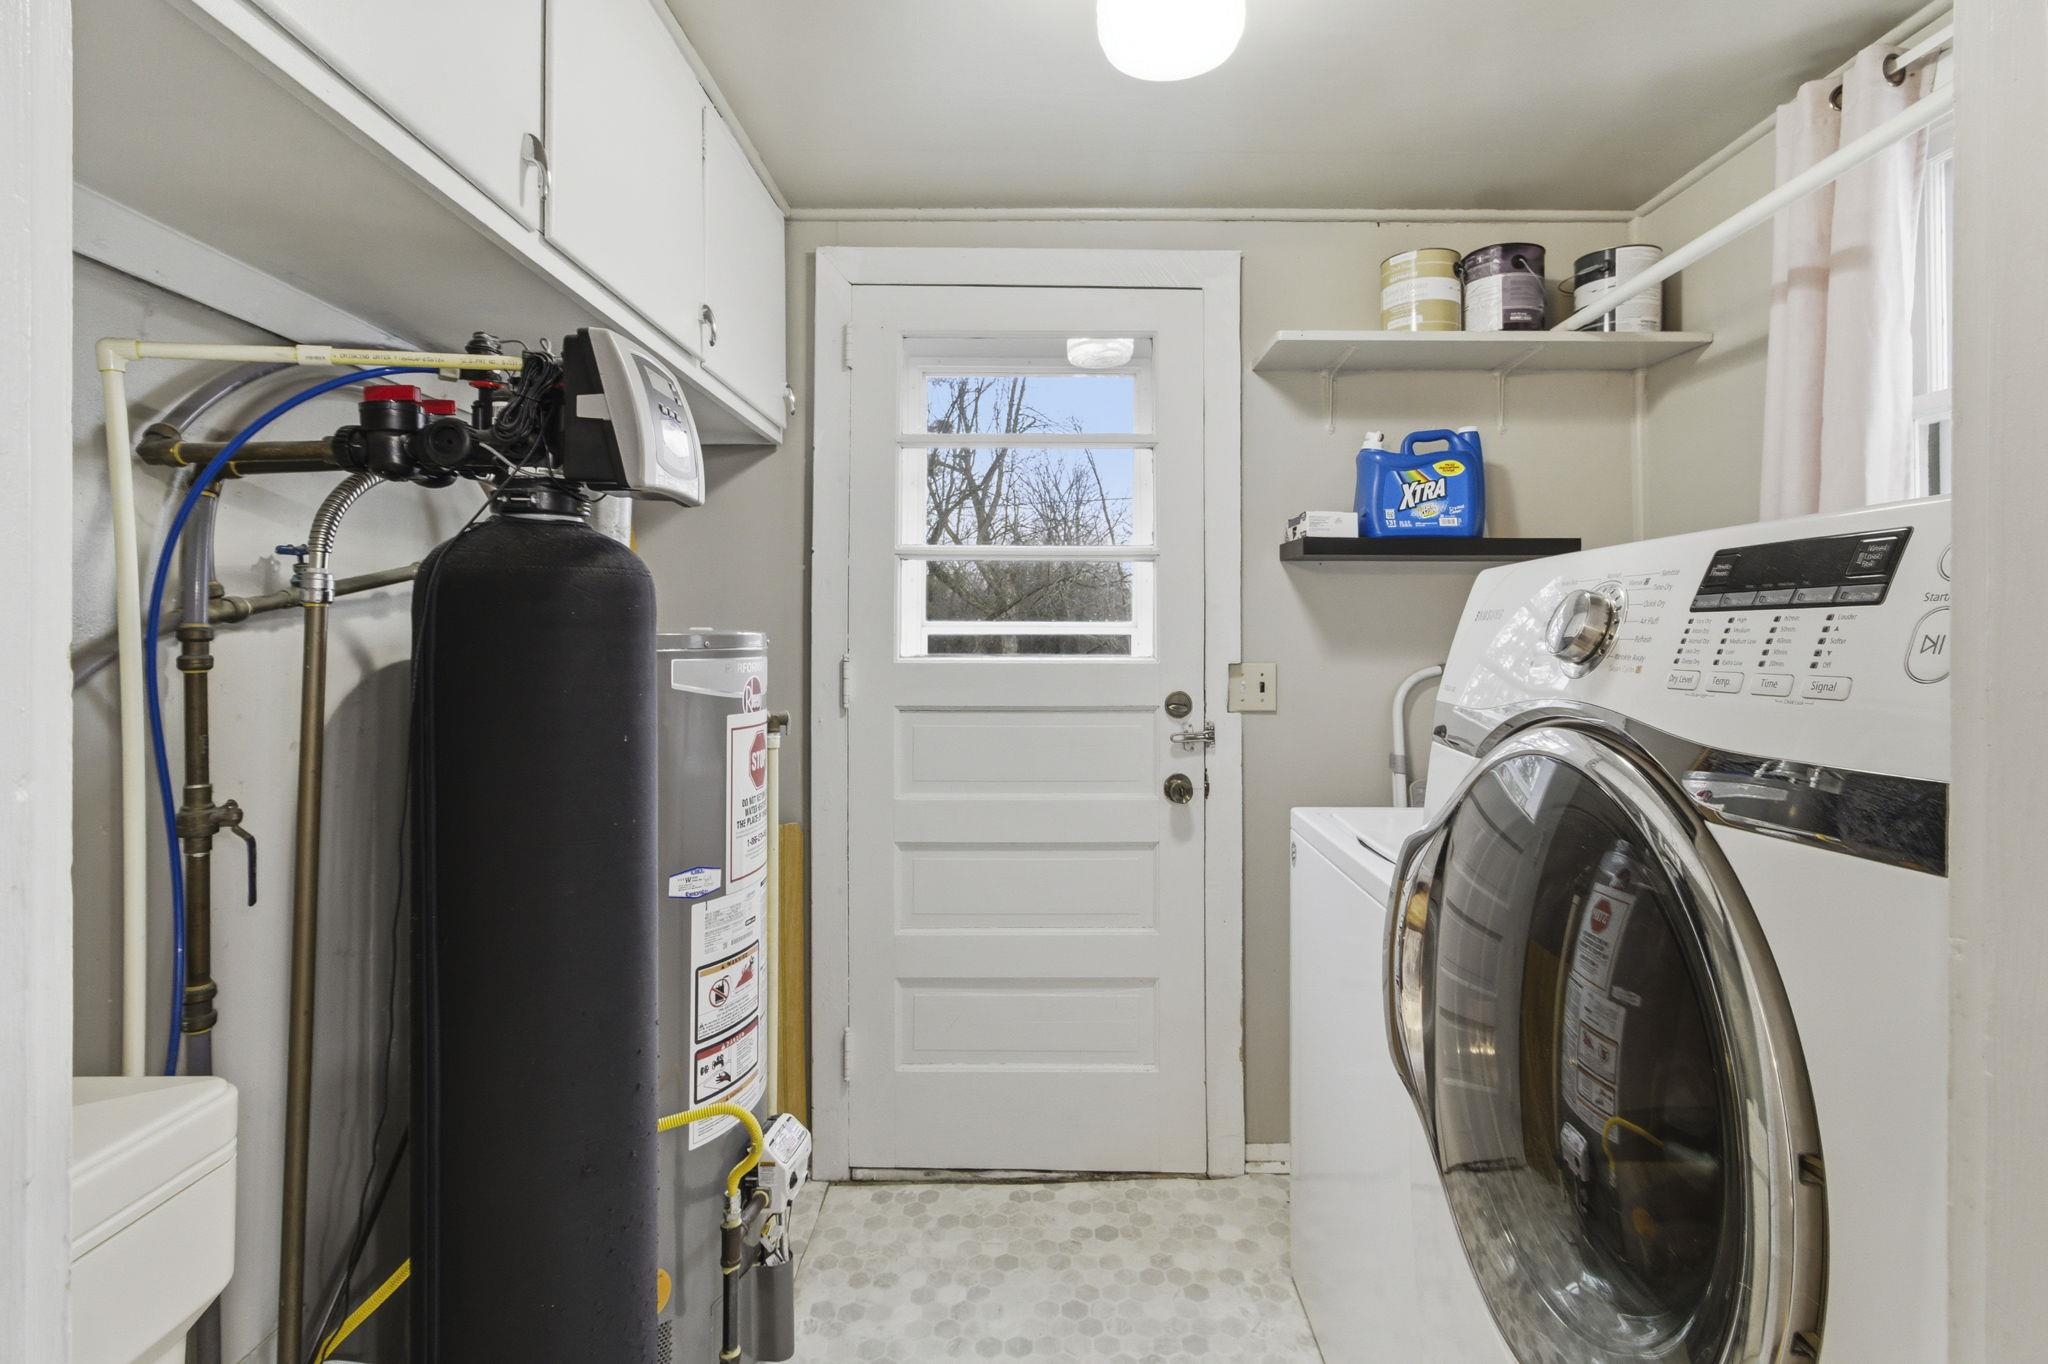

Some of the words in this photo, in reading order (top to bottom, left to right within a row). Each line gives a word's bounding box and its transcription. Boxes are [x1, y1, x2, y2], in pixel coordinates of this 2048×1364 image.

[1399, 477, 1447, 511] XTRA
[1668, 674, 1679, 685] Dry
[1679, 674, 1694, 684] Level
[1811, 681, 1838, 694] Signal
